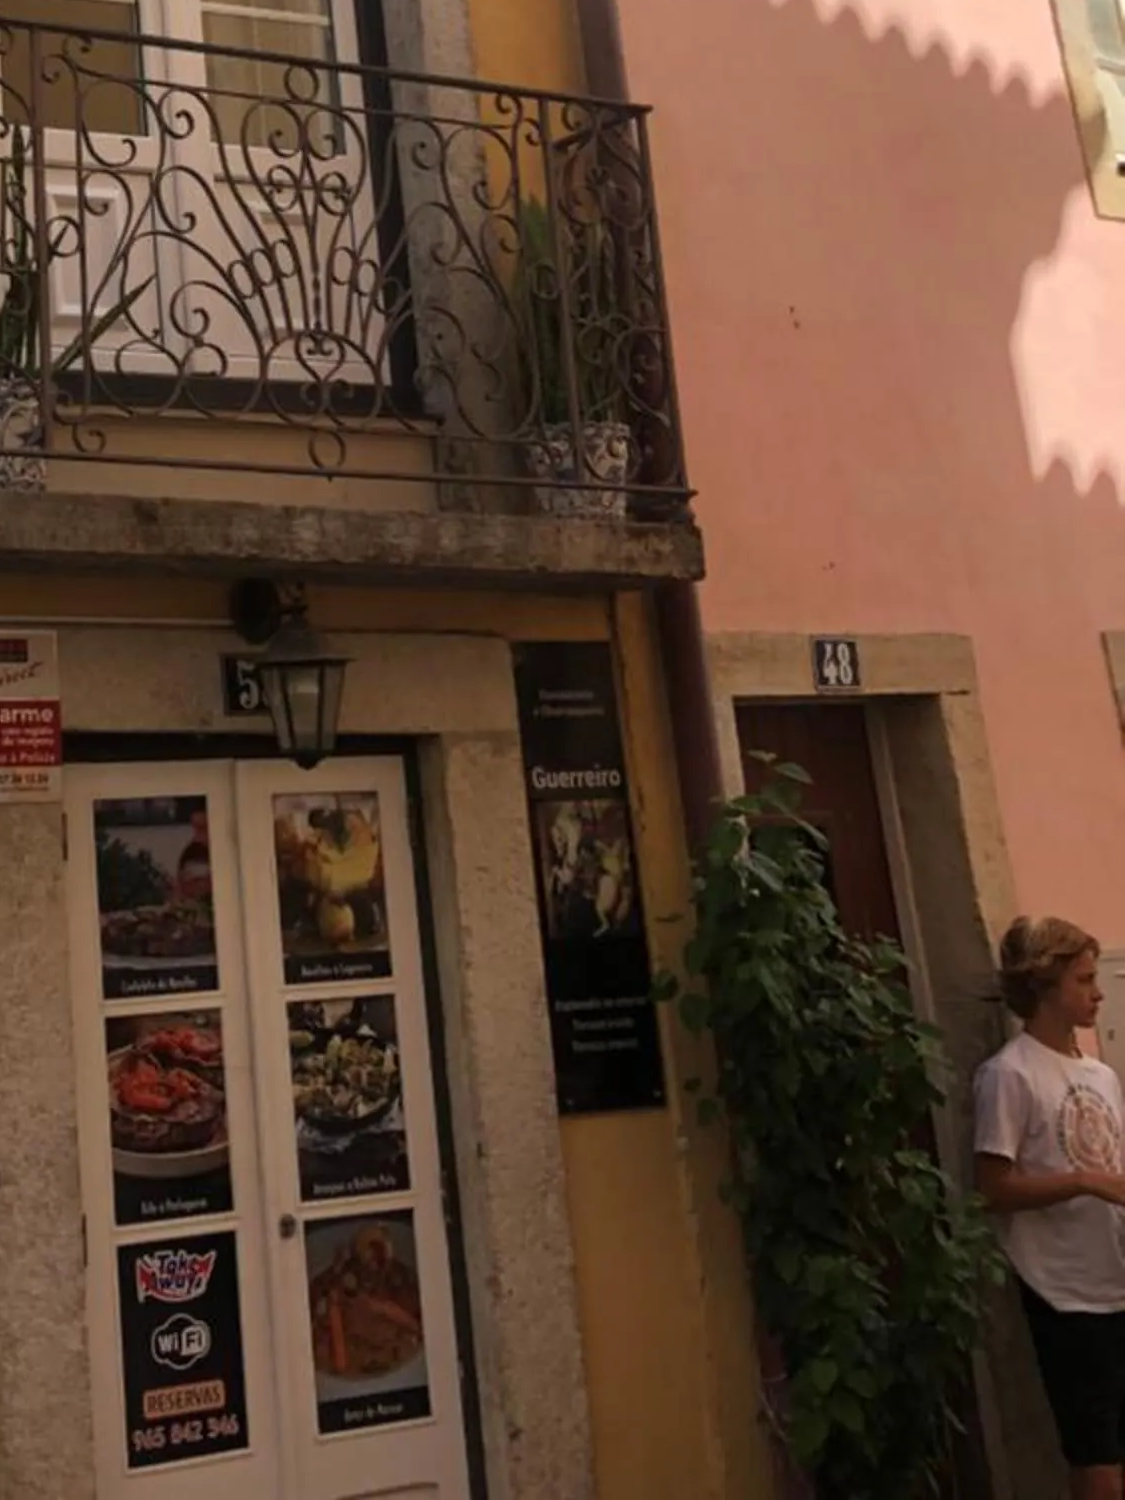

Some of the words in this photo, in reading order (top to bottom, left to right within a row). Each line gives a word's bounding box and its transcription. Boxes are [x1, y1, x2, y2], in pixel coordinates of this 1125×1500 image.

[822, 642, 854, 685] 48
[235, 659, 269, 710] 5
[531, 762, 622, 790] Guerreiro
[146, 1387, 221, 1414] RESERVAS
